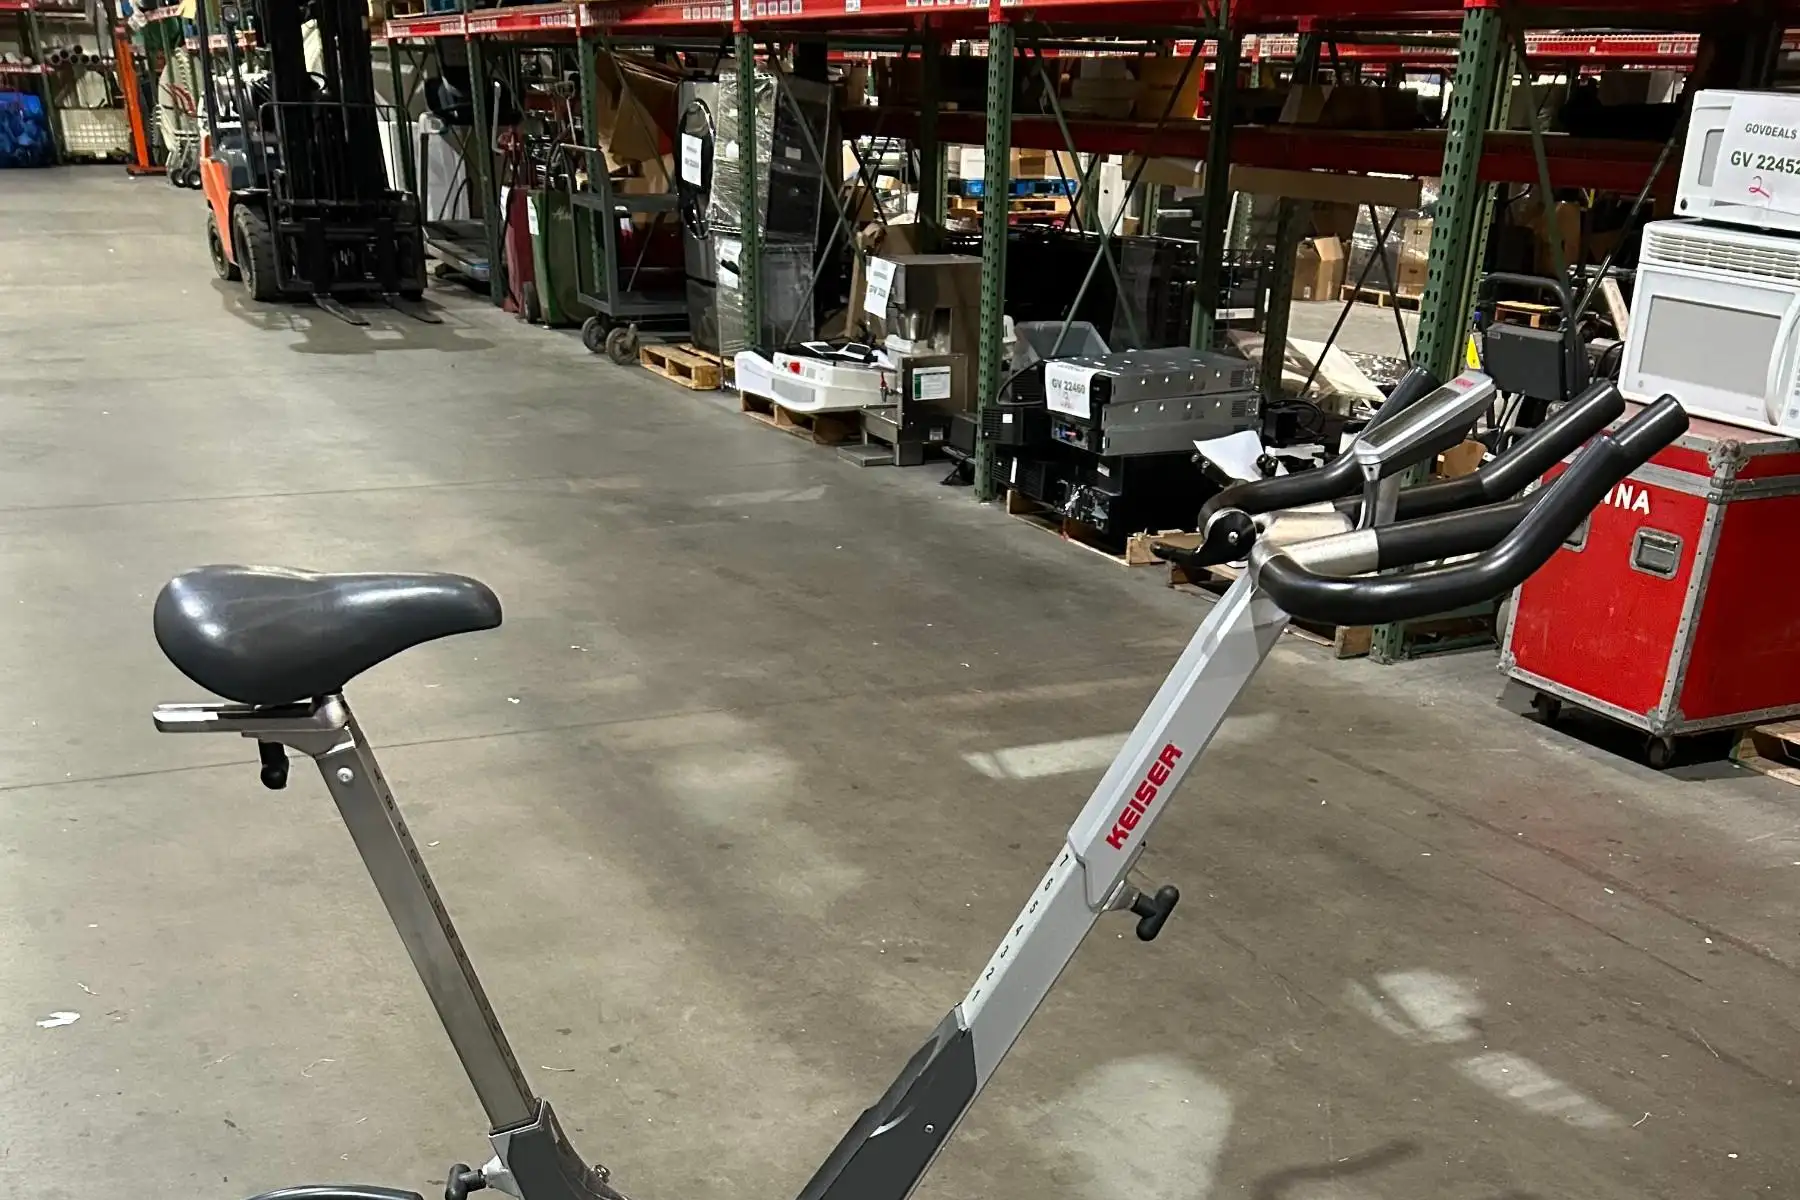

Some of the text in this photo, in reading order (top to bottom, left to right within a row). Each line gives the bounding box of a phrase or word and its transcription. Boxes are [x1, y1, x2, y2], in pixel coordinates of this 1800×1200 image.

[1745, 123, 1798, 140] GOVDEALS
[1730, 150, 1800, 175] GV 22452
[1051, 377, 1062, 389] GV
[1105, 743, 1183, 851] KEISER
[985, 966, 995, 981] 2
[972, 989, 981, 1002] 1
